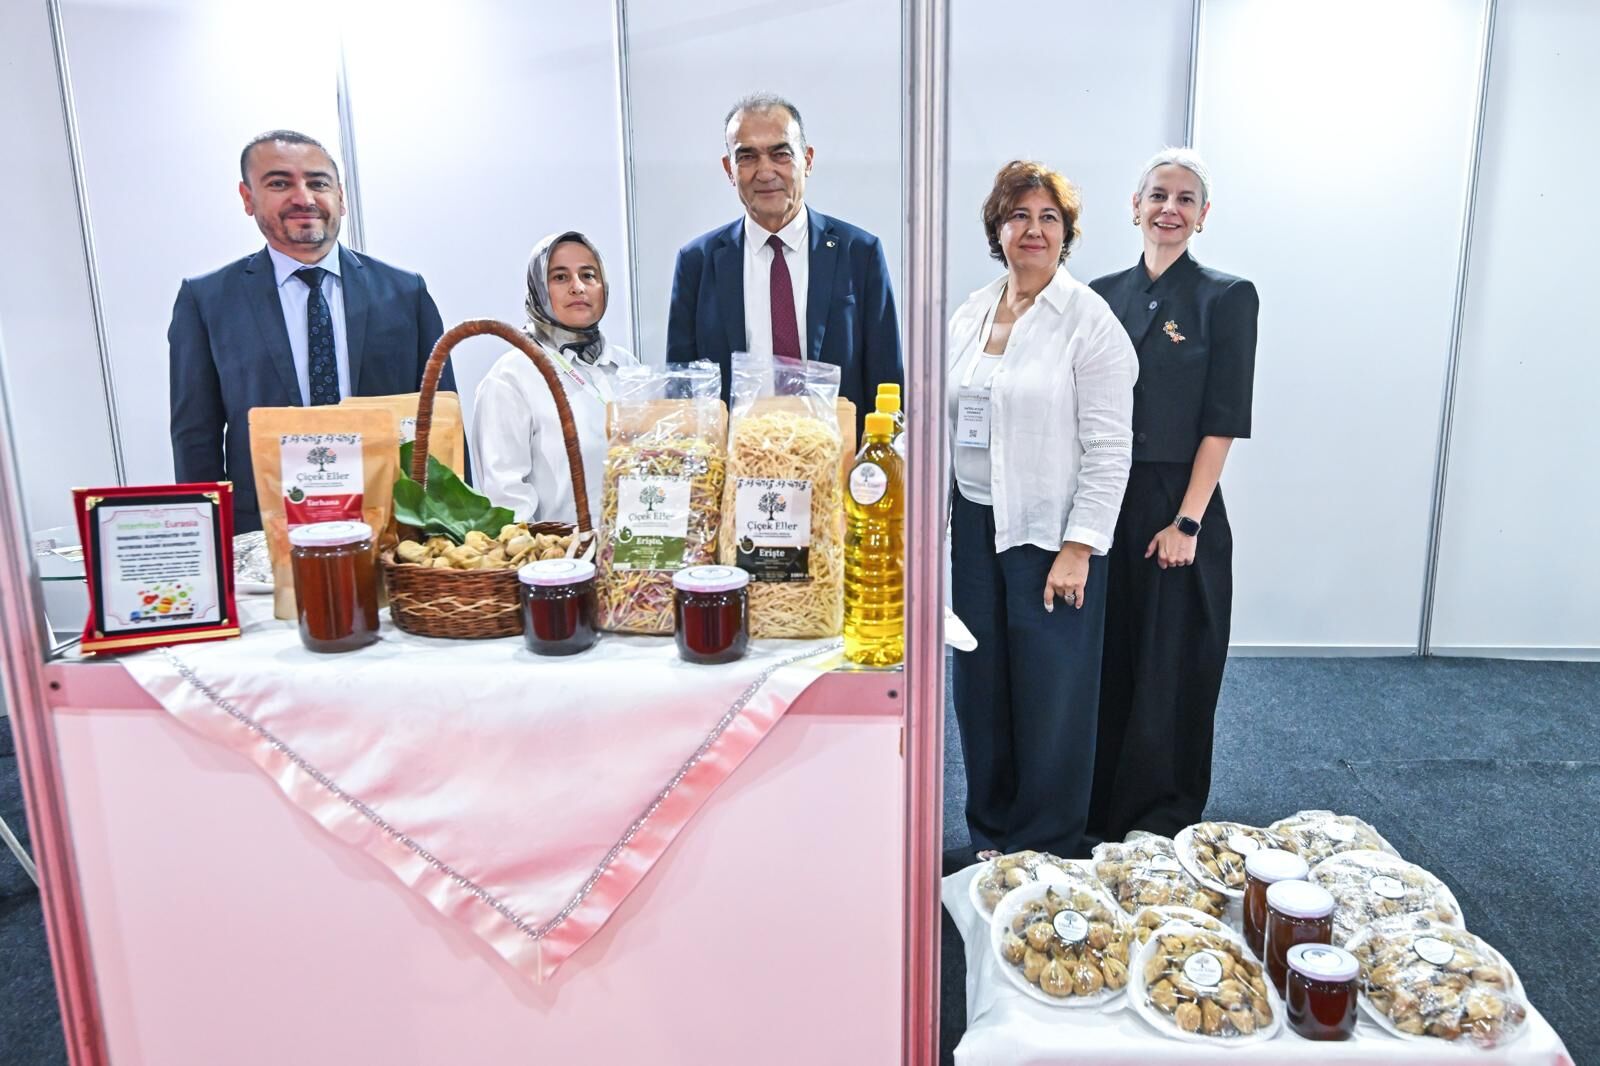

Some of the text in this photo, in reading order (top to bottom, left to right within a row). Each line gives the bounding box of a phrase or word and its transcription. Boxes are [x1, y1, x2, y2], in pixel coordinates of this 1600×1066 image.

[296, 472, 350, 482] Çiçek Eller
[164, 520, 199, 529] Eurasia
[747, 521, 798, 531] Çiçek Eller
[759, 548, 786, 559] Erişte
